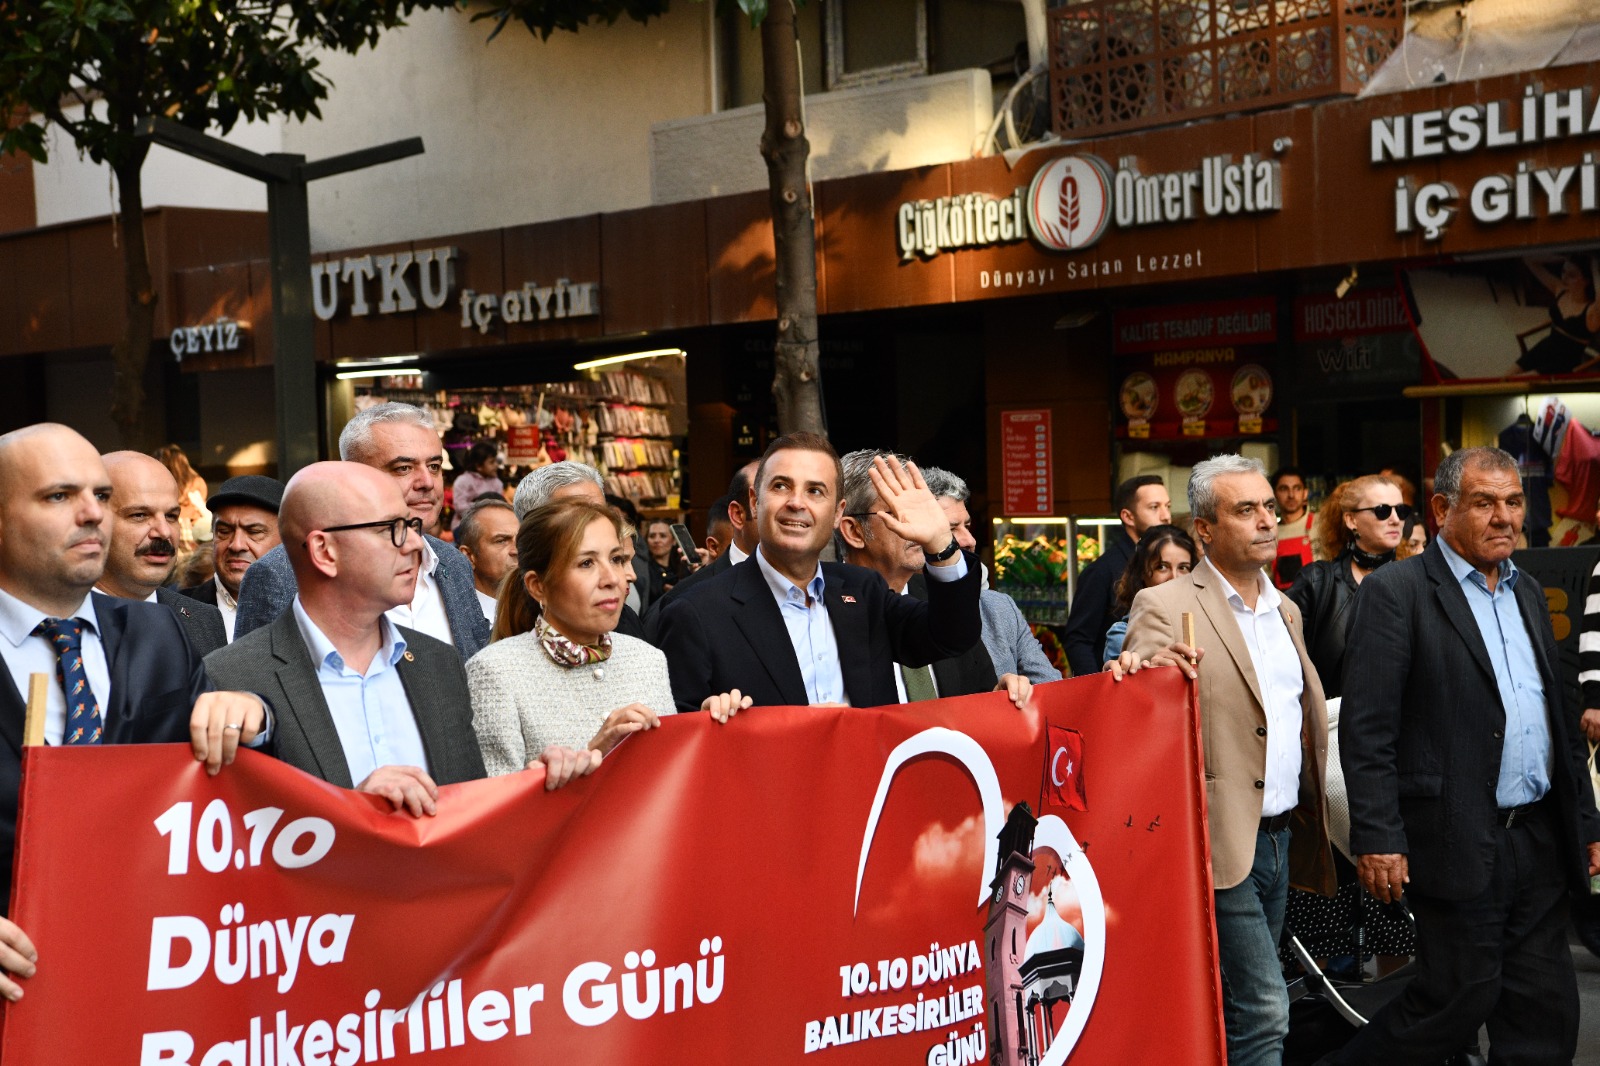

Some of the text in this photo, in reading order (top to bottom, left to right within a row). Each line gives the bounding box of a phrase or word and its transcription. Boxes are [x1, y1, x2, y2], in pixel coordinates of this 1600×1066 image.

[1371, 85, 1600, 162] NESLİH
[898, 154, 1280, 262] Çiğköfteci Ömer Usta
[1396, 176, 1452, 239] İÇ
[310, 246, 452, 320] UTKU
[979, 249, 1204, 289] Dünyayı Saran Lezzet
[460, 278, 595, 334] İÇ GİYİM
[1120, 310, 1272, 343] KALİTE TESADÜF DEĞİLDİR
[169, 316, 240, 363] ÇEYİZ
[1153, 347, 1236, 367] KAMPANYA
[154, 798, 336, 875] 10.10
[147, 902, 355, 994] Dünya
[839, 940, 982, 998] 10.10 DÜNYA
[562, 935, 725, 1027] Günü
[804, 985, 985, 1054] BALIKESİRLİLER
[927, 1022, 987, 1066] GÜNÜ
